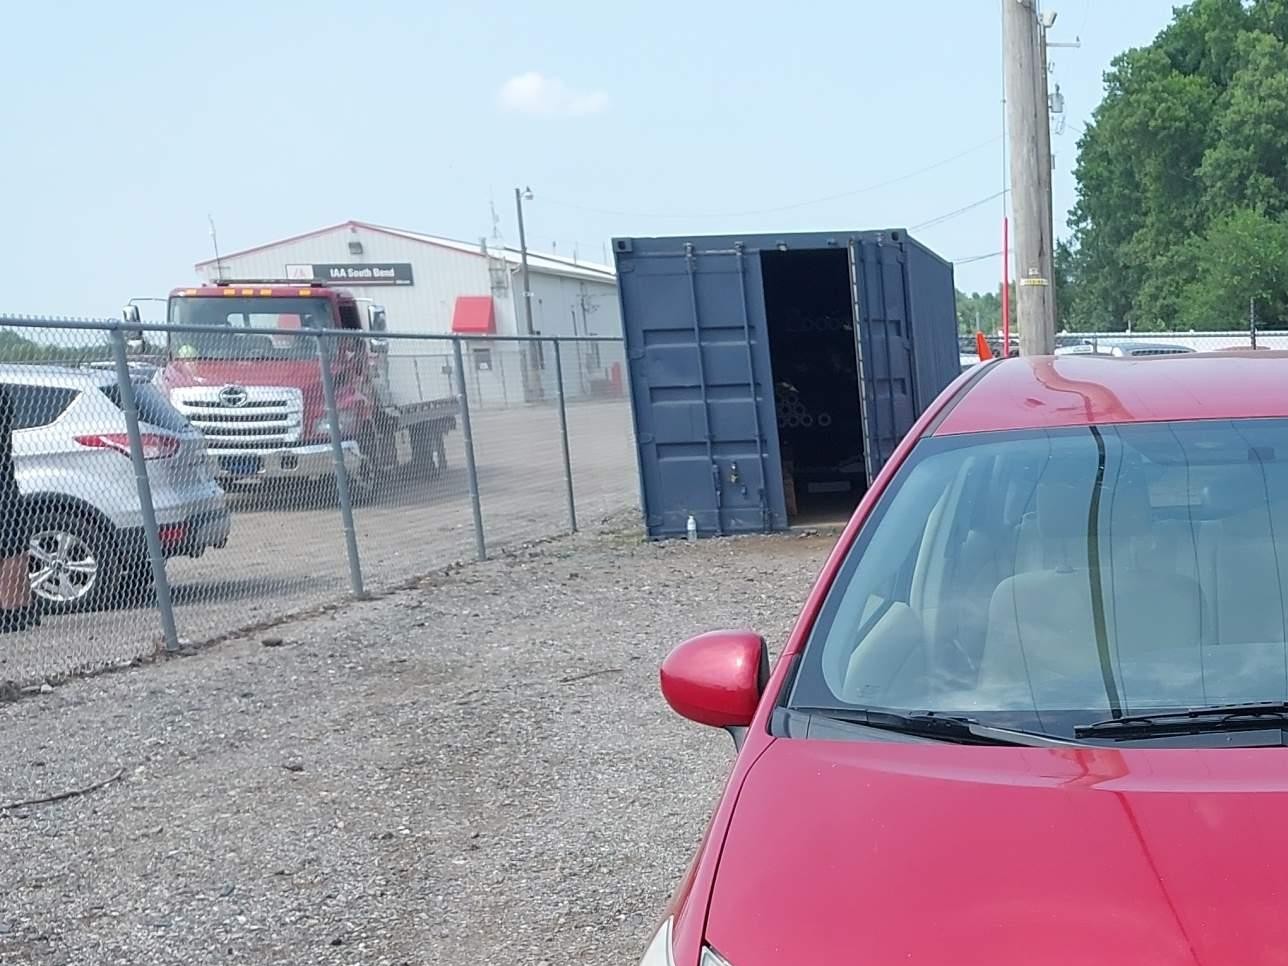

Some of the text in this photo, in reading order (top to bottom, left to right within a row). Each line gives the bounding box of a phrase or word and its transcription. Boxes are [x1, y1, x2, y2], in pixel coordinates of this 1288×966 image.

[330, 267, 395, 278] IAA South Bend
